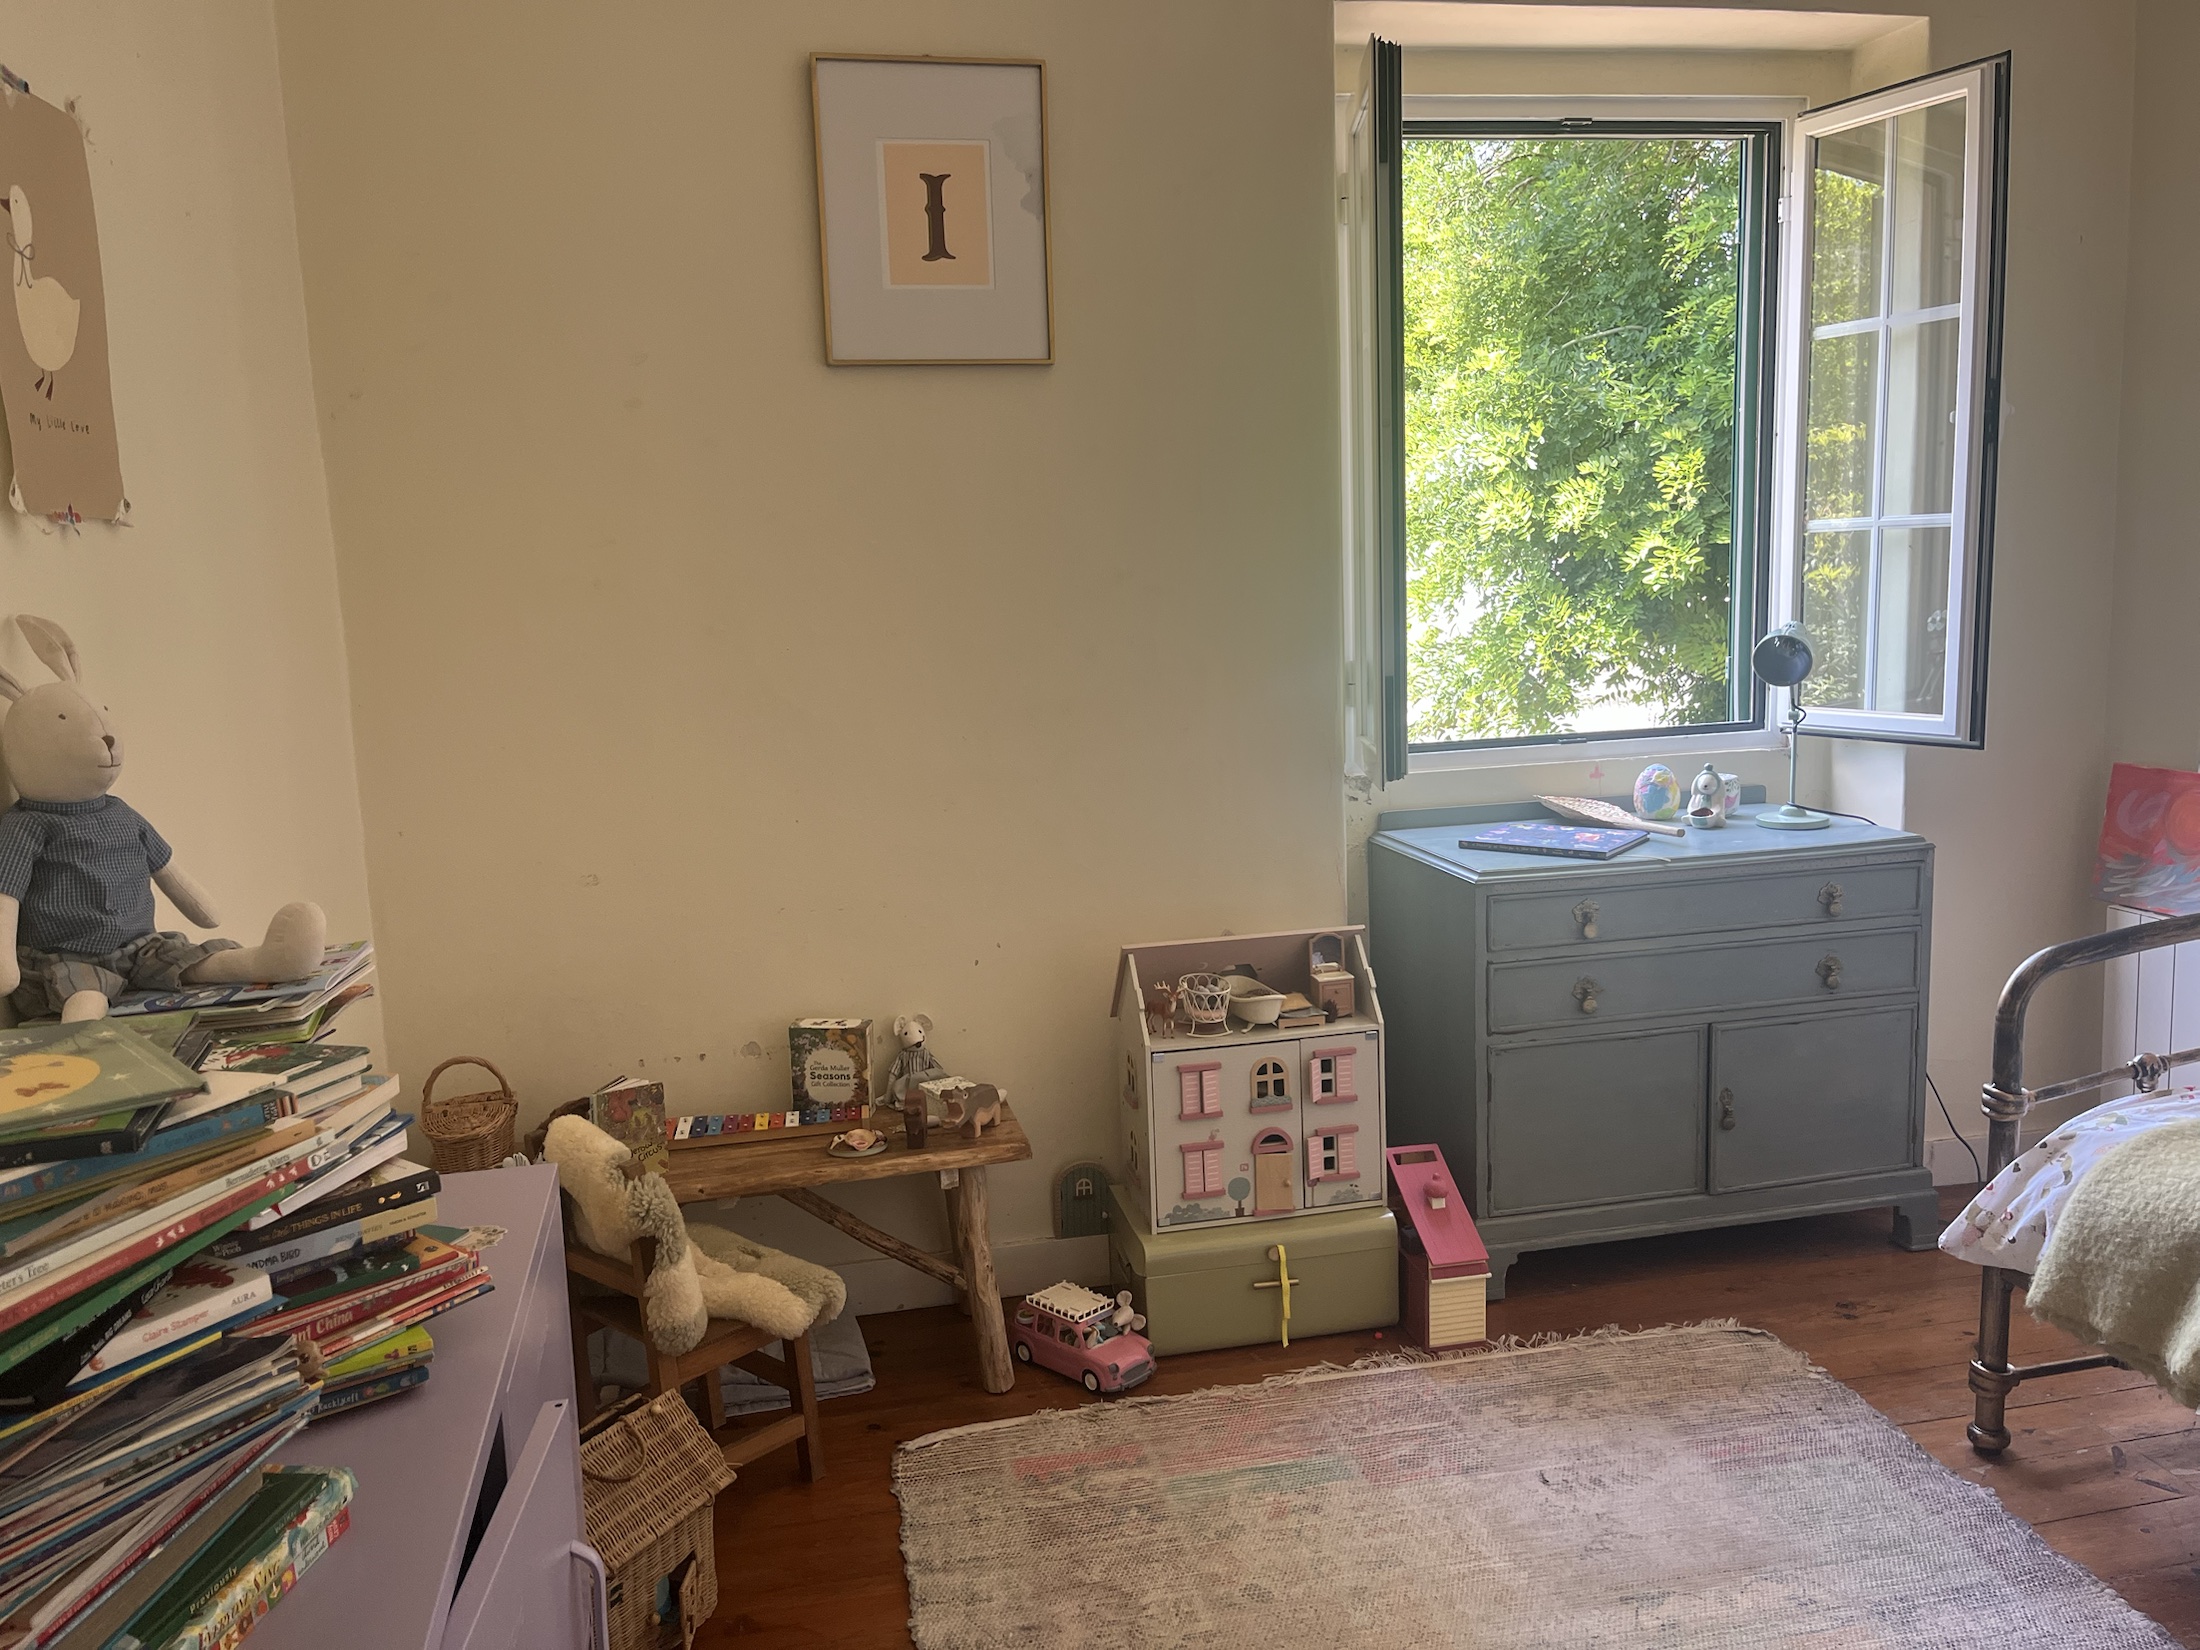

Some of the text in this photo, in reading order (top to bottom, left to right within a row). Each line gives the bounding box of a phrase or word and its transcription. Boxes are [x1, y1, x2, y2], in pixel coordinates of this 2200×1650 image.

[919, 172, 957, 262] I
[809, 1071, 851, 1080] Seasons
[637, 1143, 663, 1162] Circus
[290, 1213, 330, 1233] THINGS
[330, 1210, 341, 1220] IN
[341, 1202, 364, 1217] LIFE
[280, 1248, 301, 1263] BIRD
[25, 1261, 50, 1280] Tree
[230, 1290, 257, 1307] AURA
[141, 1309, 209, 1344] Claire Stamper
[316, 1310, 353, 1335] China
[188, 1564, 239, 1615] Previously
